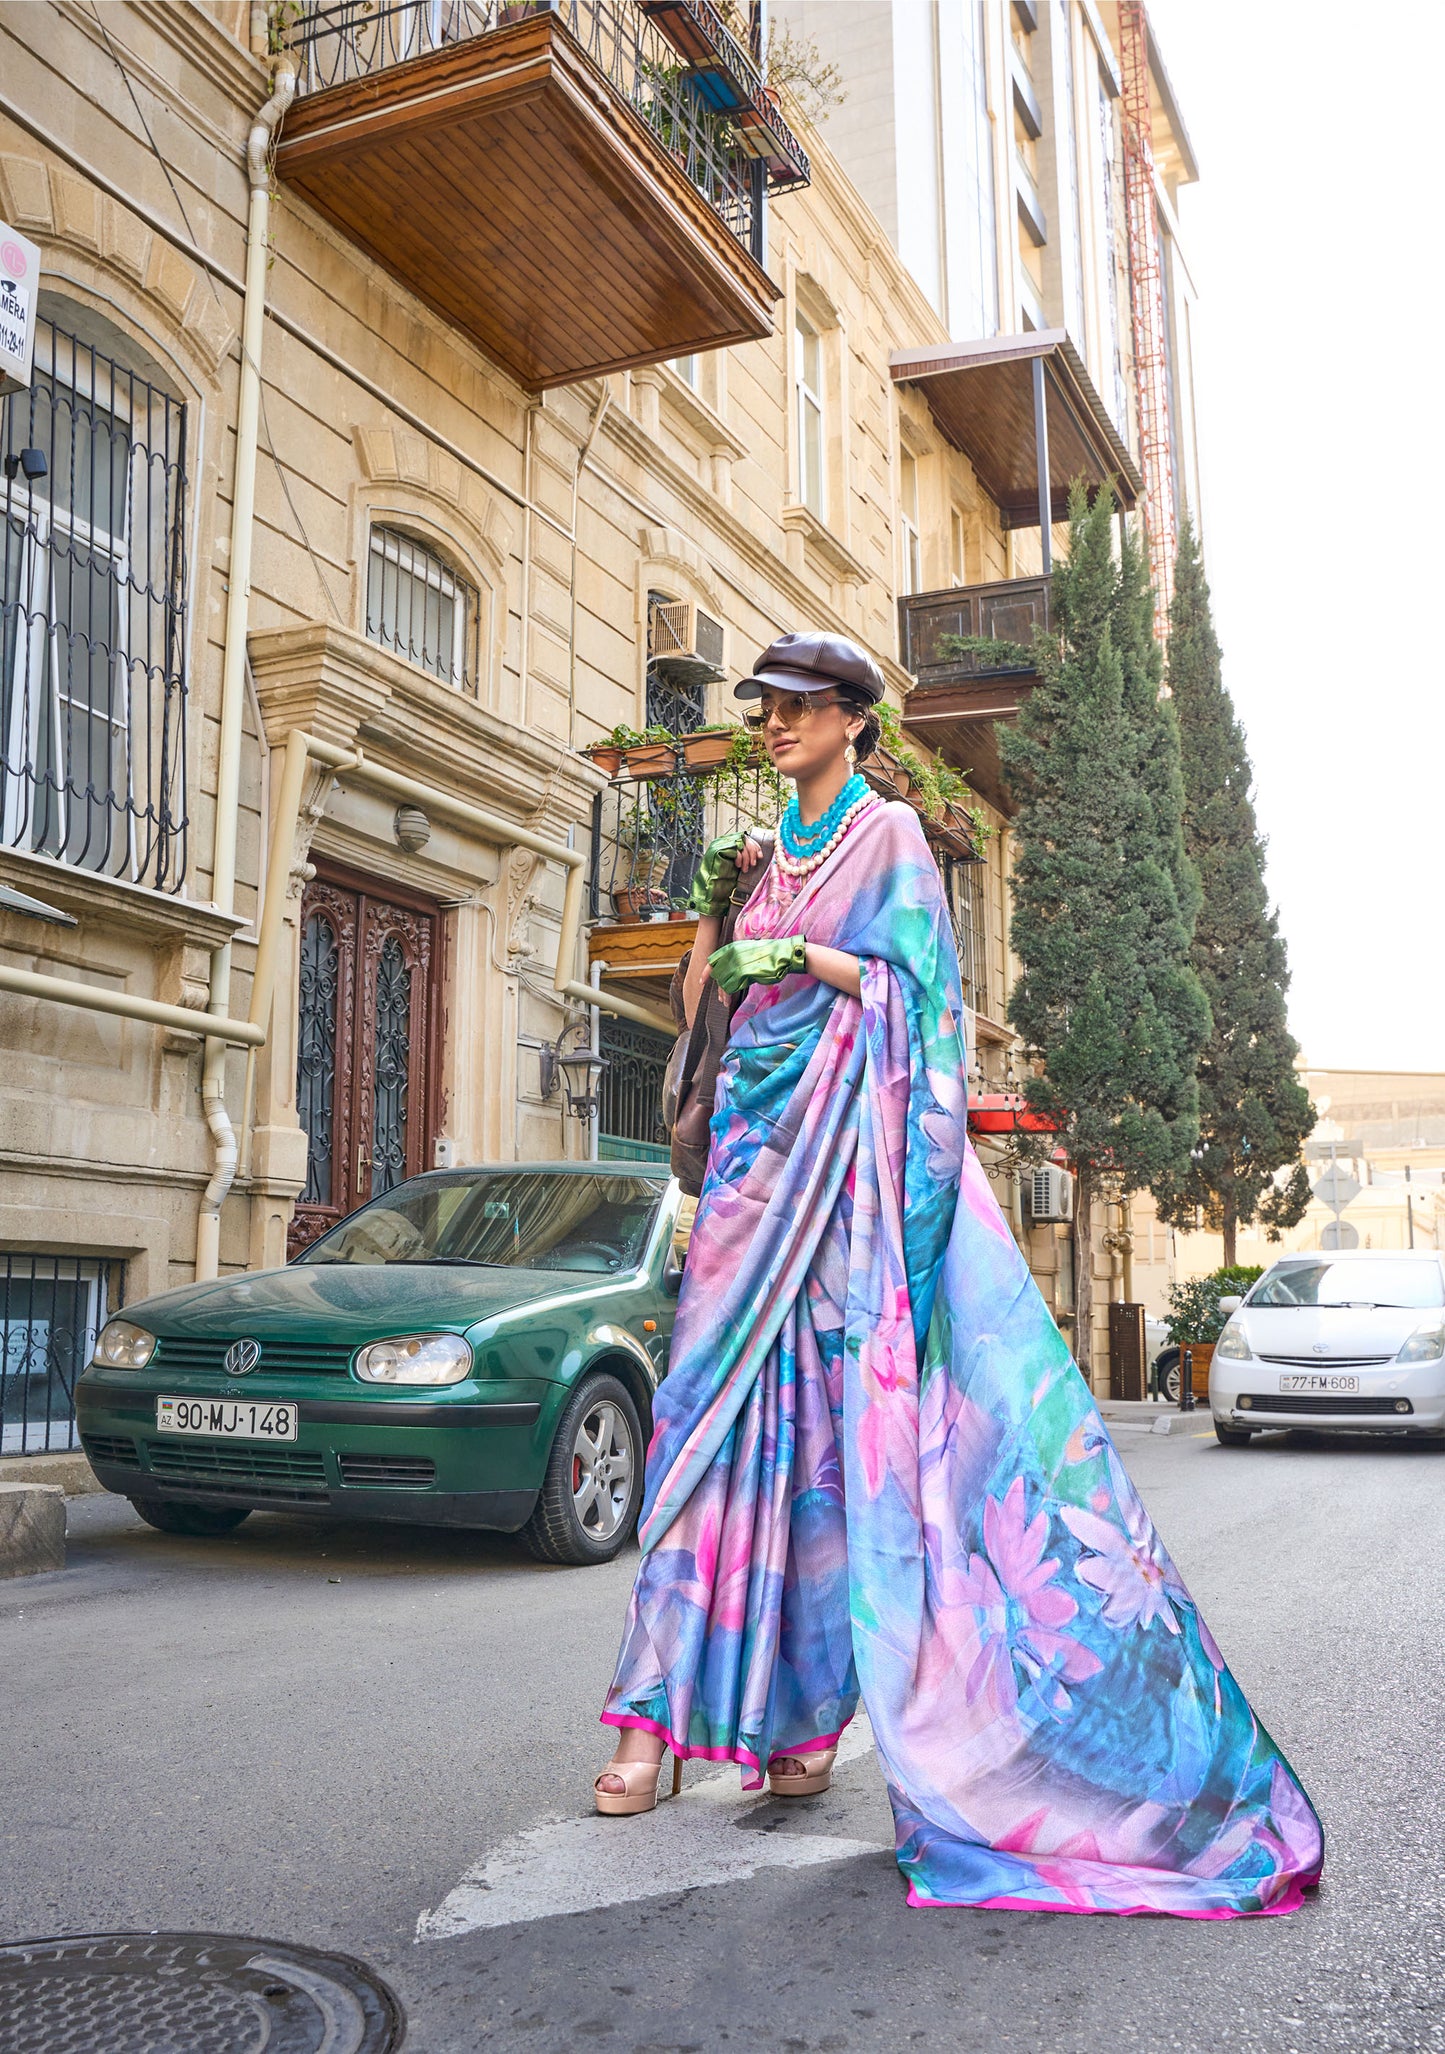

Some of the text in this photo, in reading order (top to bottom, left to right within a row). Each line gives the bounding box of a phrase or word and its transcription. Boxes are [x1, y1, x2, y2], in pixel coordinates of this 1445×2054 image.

[0, 294, 25, 323] MERA
[1292, 1376, 1355, 1390] 77-FM-608
[160, 1415, 172, 1425] AZ
[177, 1402, 290, 1435] 90-MJ-148
